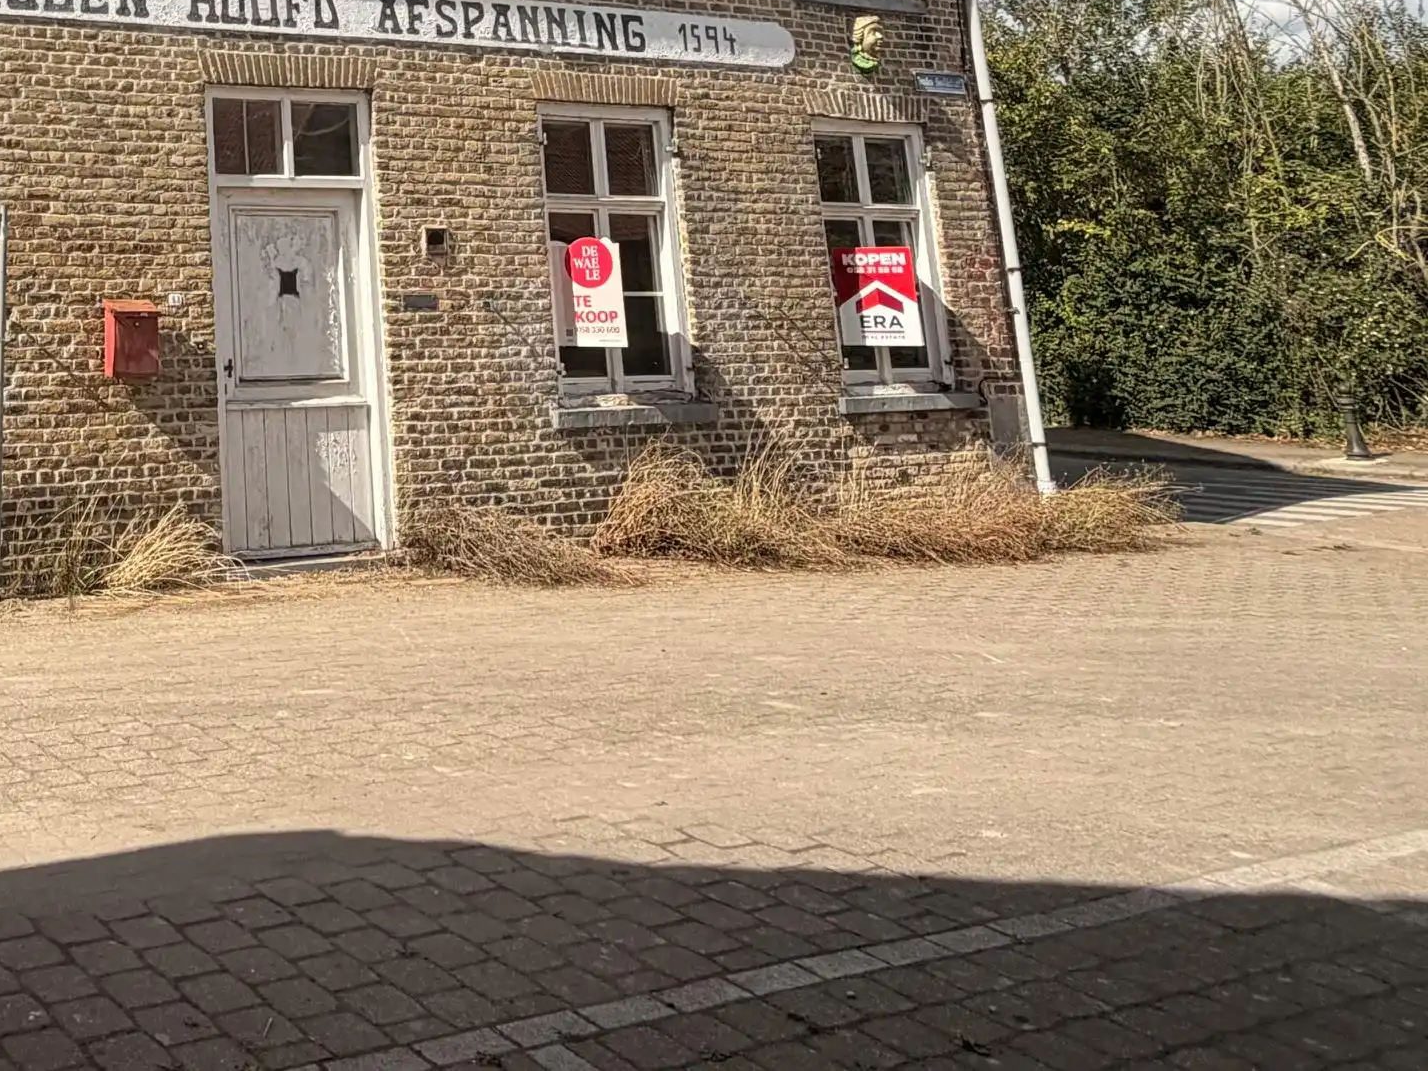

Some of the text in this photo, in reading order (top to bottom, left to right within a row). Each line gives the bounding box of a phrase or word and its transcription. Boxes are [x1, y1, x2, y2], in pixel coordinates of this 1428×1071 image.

[678, 23, 738, 55] 1594
[581, 245, 599, 258] DE
[573, 257, 600, 269] WAE
[841, 252, 907, 266] KOPEN
[585, 269, 601, 281] LE
[573, 295, 592, 308] TE
[574, 310, 619, 324] KOOP
[860, 314, 904, 329] ERA
